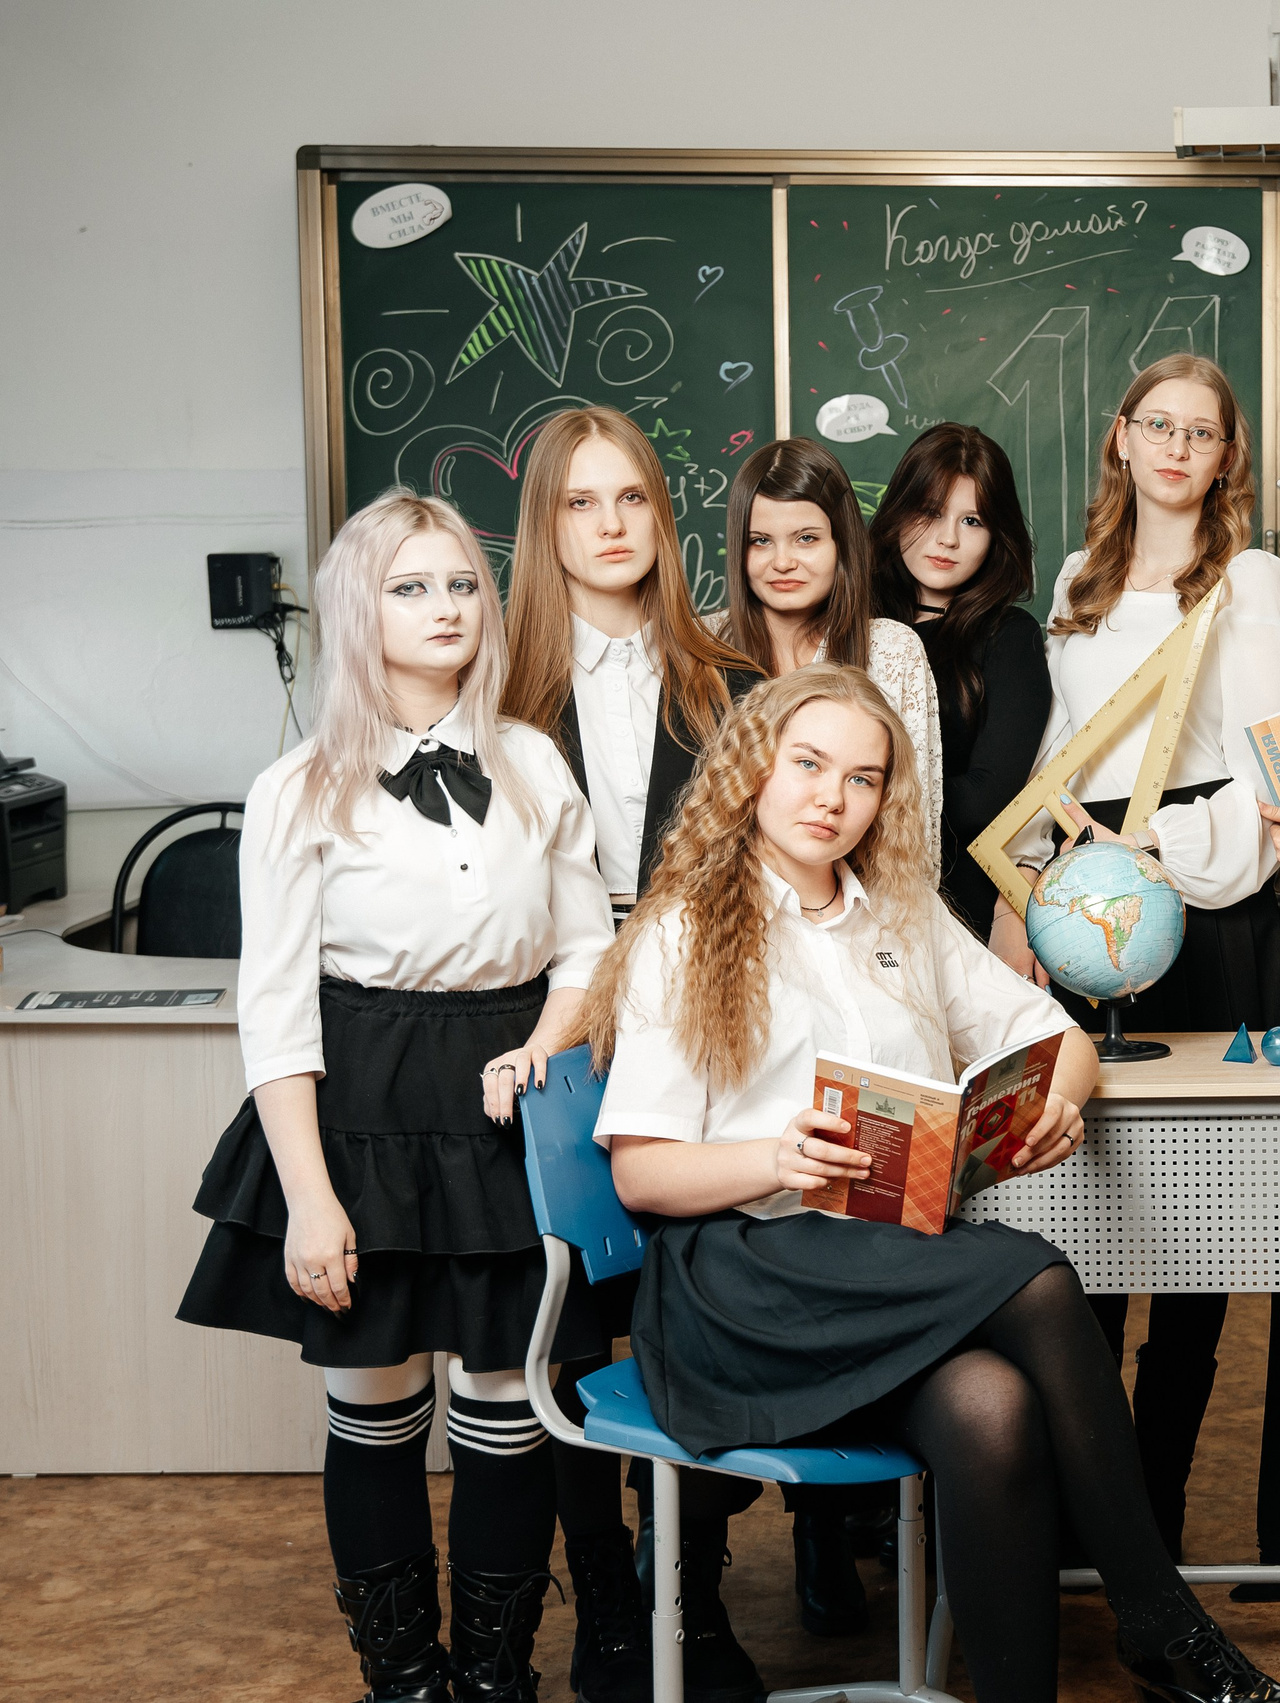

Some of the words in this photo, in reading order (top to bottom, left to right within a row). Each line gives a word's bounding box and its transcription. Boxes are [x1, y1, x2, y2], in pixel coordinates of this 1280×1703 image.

[371, 192, 426, 218] ВМЕСТЕ
[390, 210, 415, 226] МЫ
[387, 223, 425, 241] СИЛА
[883, 203, 1002, 280] Когда
[1009, 200, 1149, 266] домой?
[843, 423, 875, 436] СИБУР
[966, 1073, 1042, 1121] Геометрия
[1018, 1086, 1037, 1107] 11
